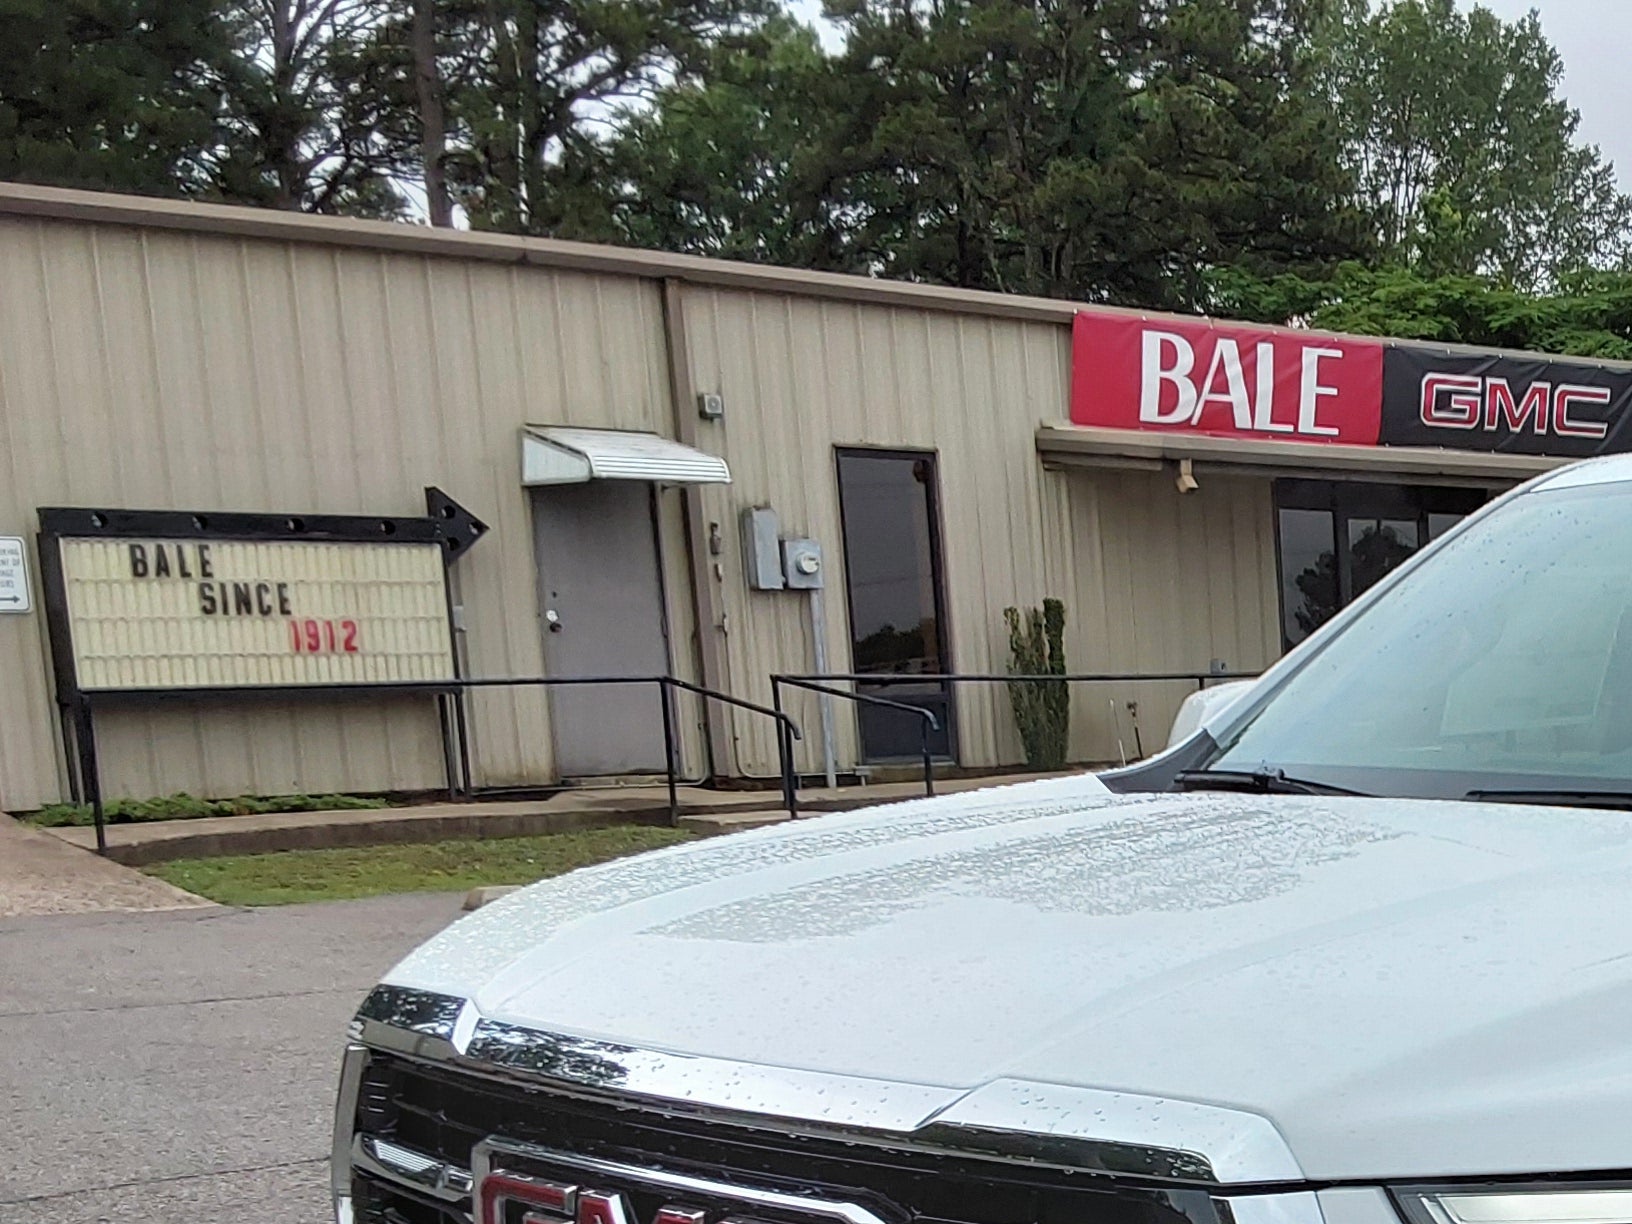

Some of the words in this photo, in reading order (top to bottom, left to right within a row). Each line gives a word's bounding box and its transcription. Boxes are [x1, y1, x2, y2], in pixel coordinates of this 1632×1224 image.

[1139, 329, 1343, 436] BALE
[1420, 371, 1611, 439] GMC
[130, 543, 214, 579] BALE
[201, 582, 293, 617] SINCE
[290, 619, 359, 653] 1912
